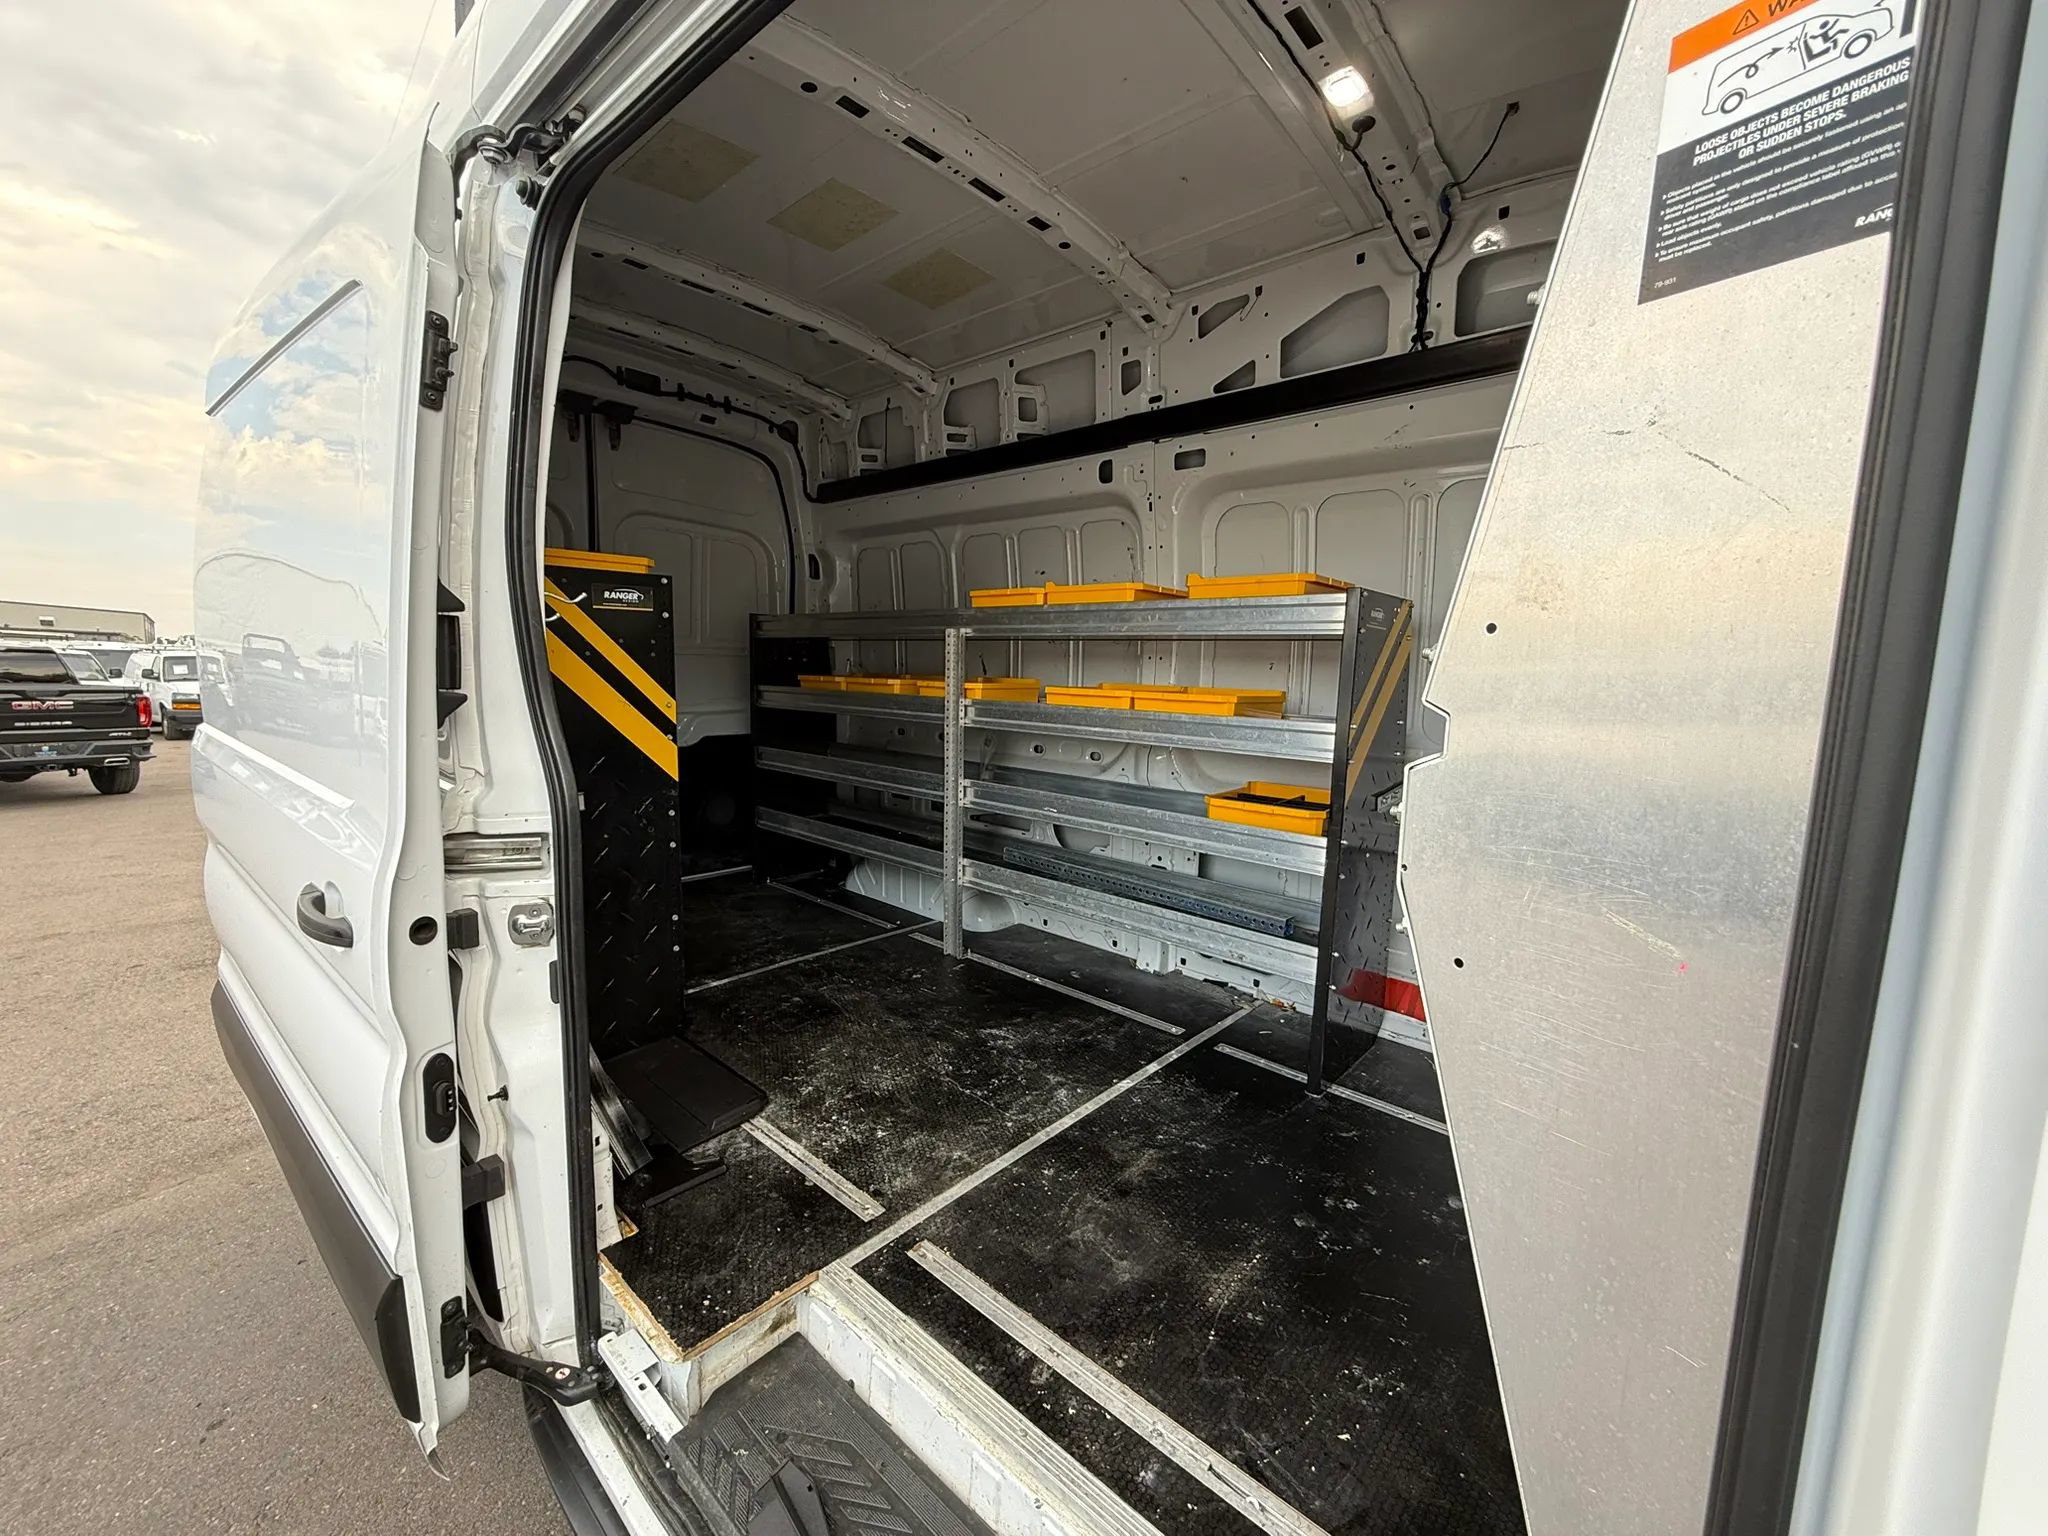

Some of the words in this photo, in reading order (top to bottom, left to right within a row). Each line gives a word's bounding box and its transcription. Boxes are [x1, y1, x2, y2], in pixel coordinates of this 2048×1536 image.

[1693, 131, 1761, 166] PROJECTILES
[1763, 115, 1801, 137] UNDER
[1803, 95, 1849, 121] SEVERE
[1851, 70, 1909, 102] BRAKING
[1695, 133, 1728, 154] LOOSE
[1730, 112, 1779, 140] OBJECTS
[1781, 90, 1830, 119] BECOME
[1832, 57, 1910, 97] DANGEROUS
[1738, 145, 1755, 159] OR
[1756, 126, 1802, 152] SUDDEN
[1804, 109, 1847, 133] STOPS.
[1668, 186, 1690, 198] Objects
[604, 591, 638, 600] RANGER
[11, 701, 74, 710] GMC
